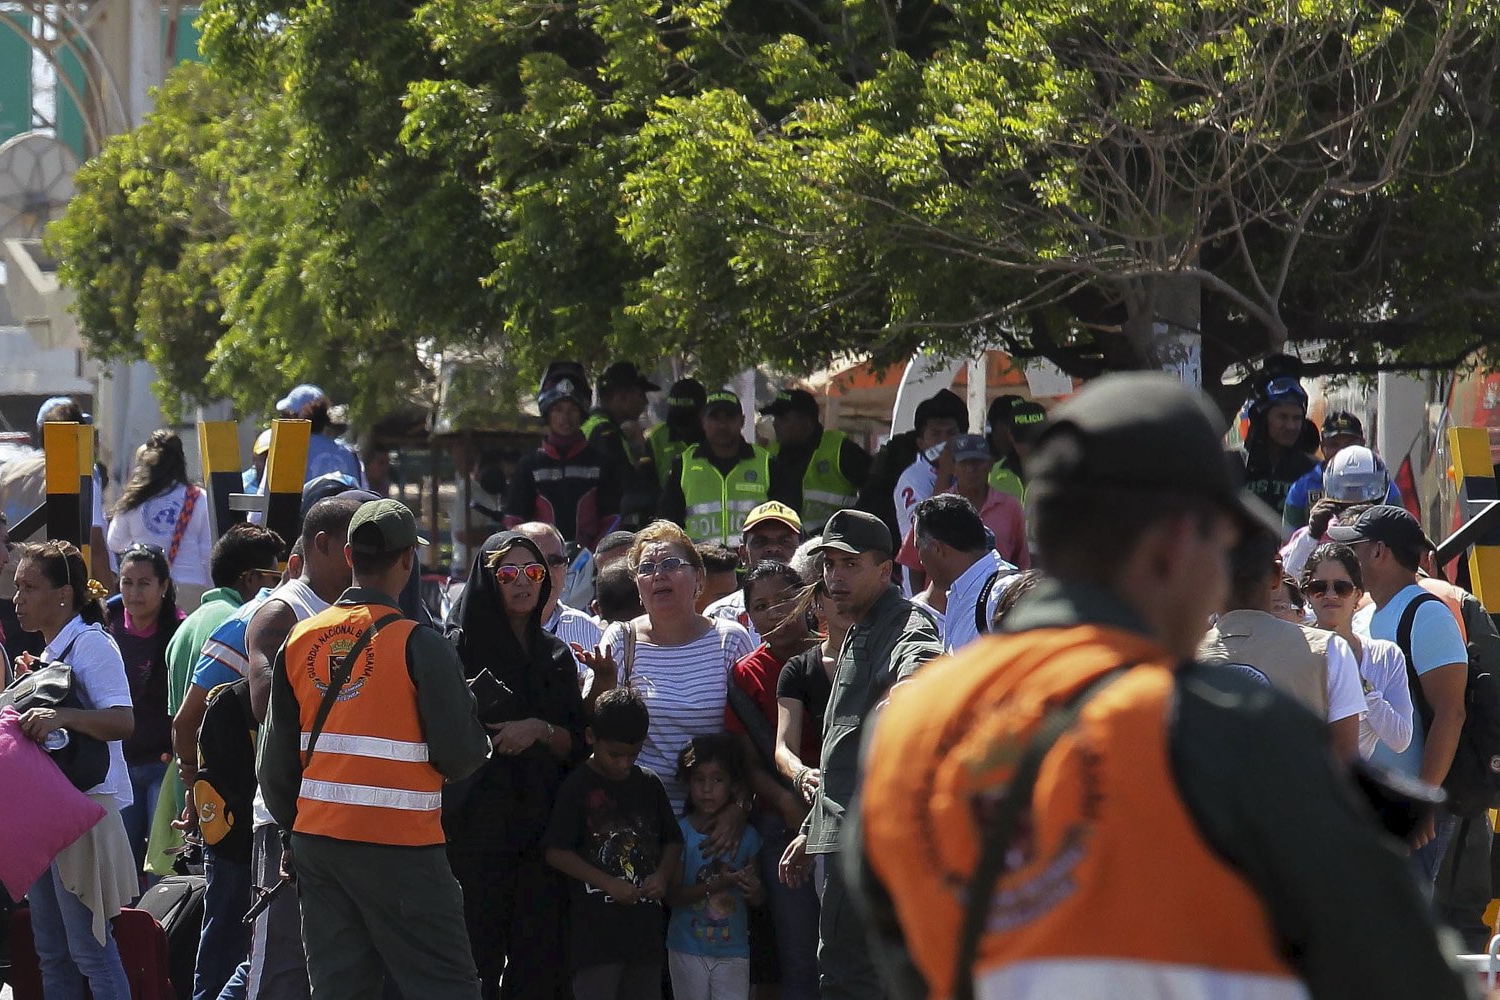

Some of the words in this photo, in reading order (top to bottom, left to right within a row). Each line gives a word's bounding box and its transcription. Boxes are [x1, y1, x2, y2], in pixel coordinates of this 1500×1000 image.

[759, 502, 784, 515] CAT
[901, 487, 915, 510] 2
[307, 643, 321, 679] GUARDIA
[318, 625, 355, 645] NACIONAL
